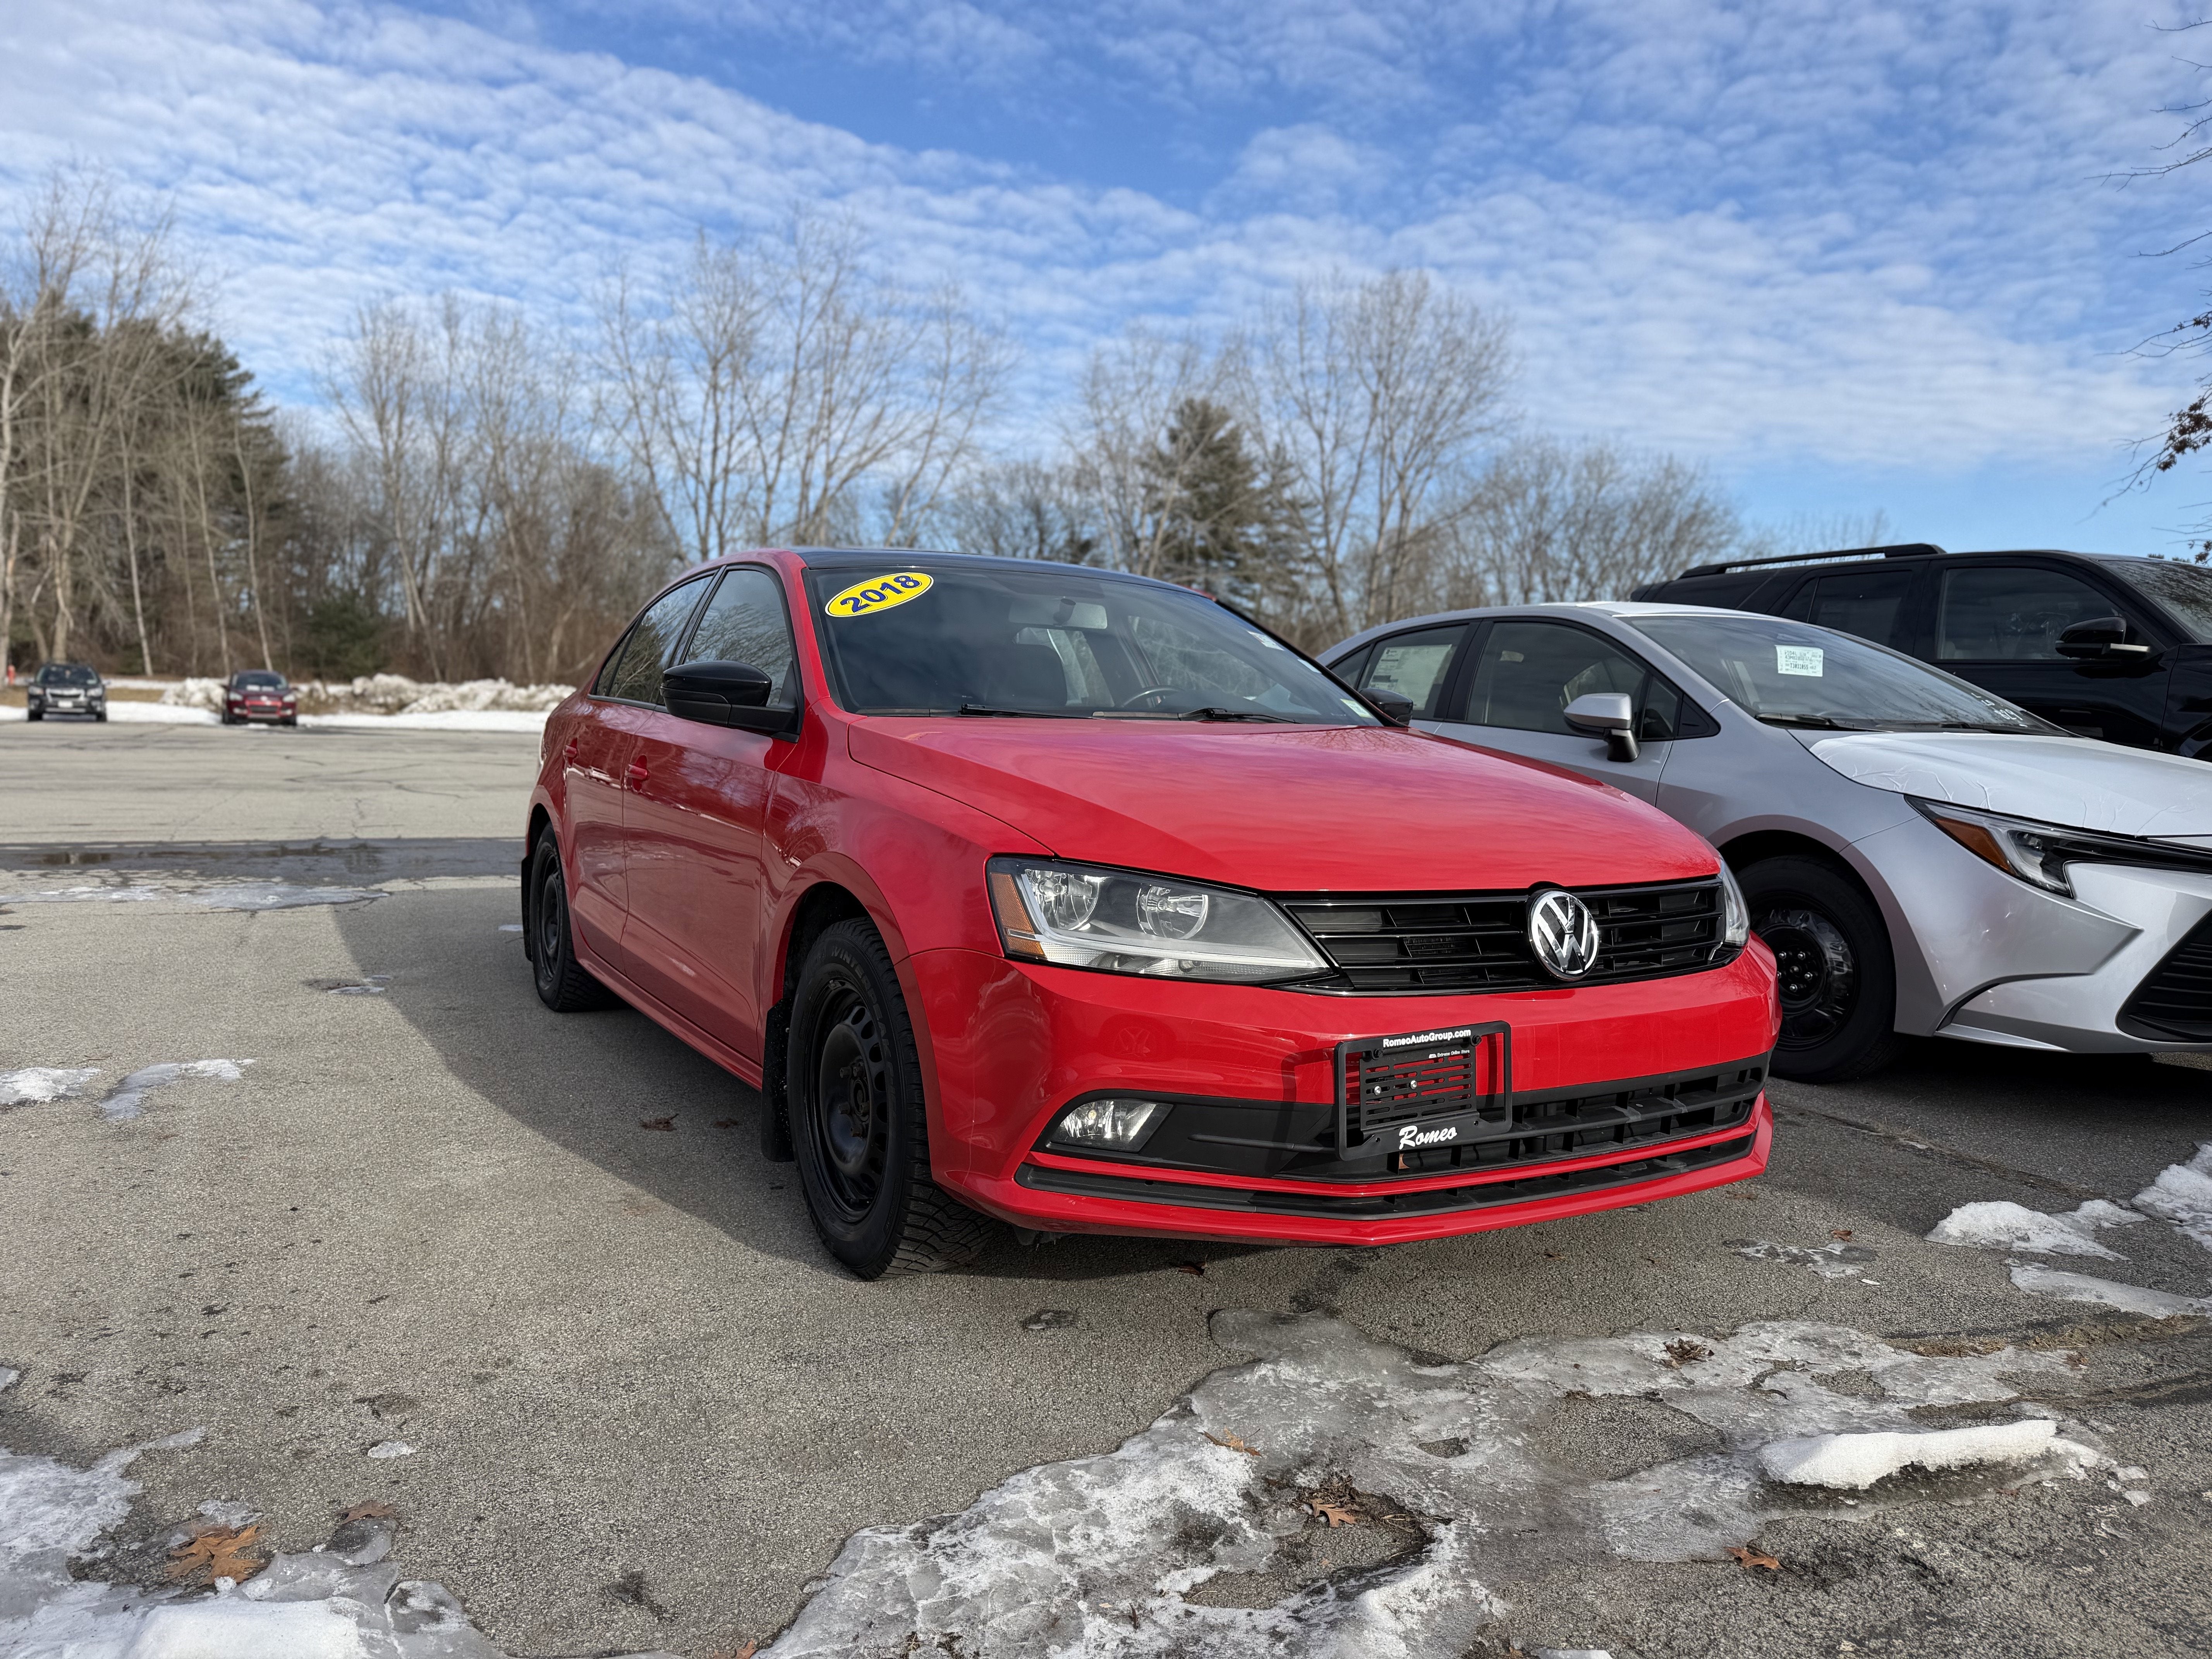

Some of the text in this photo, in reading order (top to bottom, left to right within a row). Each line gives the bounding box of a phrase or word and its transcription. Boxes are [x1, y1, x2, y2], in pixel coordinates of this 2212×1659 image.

[840, 575, 922, 613] 2018
[1382, 1029, 1471, 1048] RomeoAutoGroup.com
[1398, 1125, 1458, 1150] Romeo
